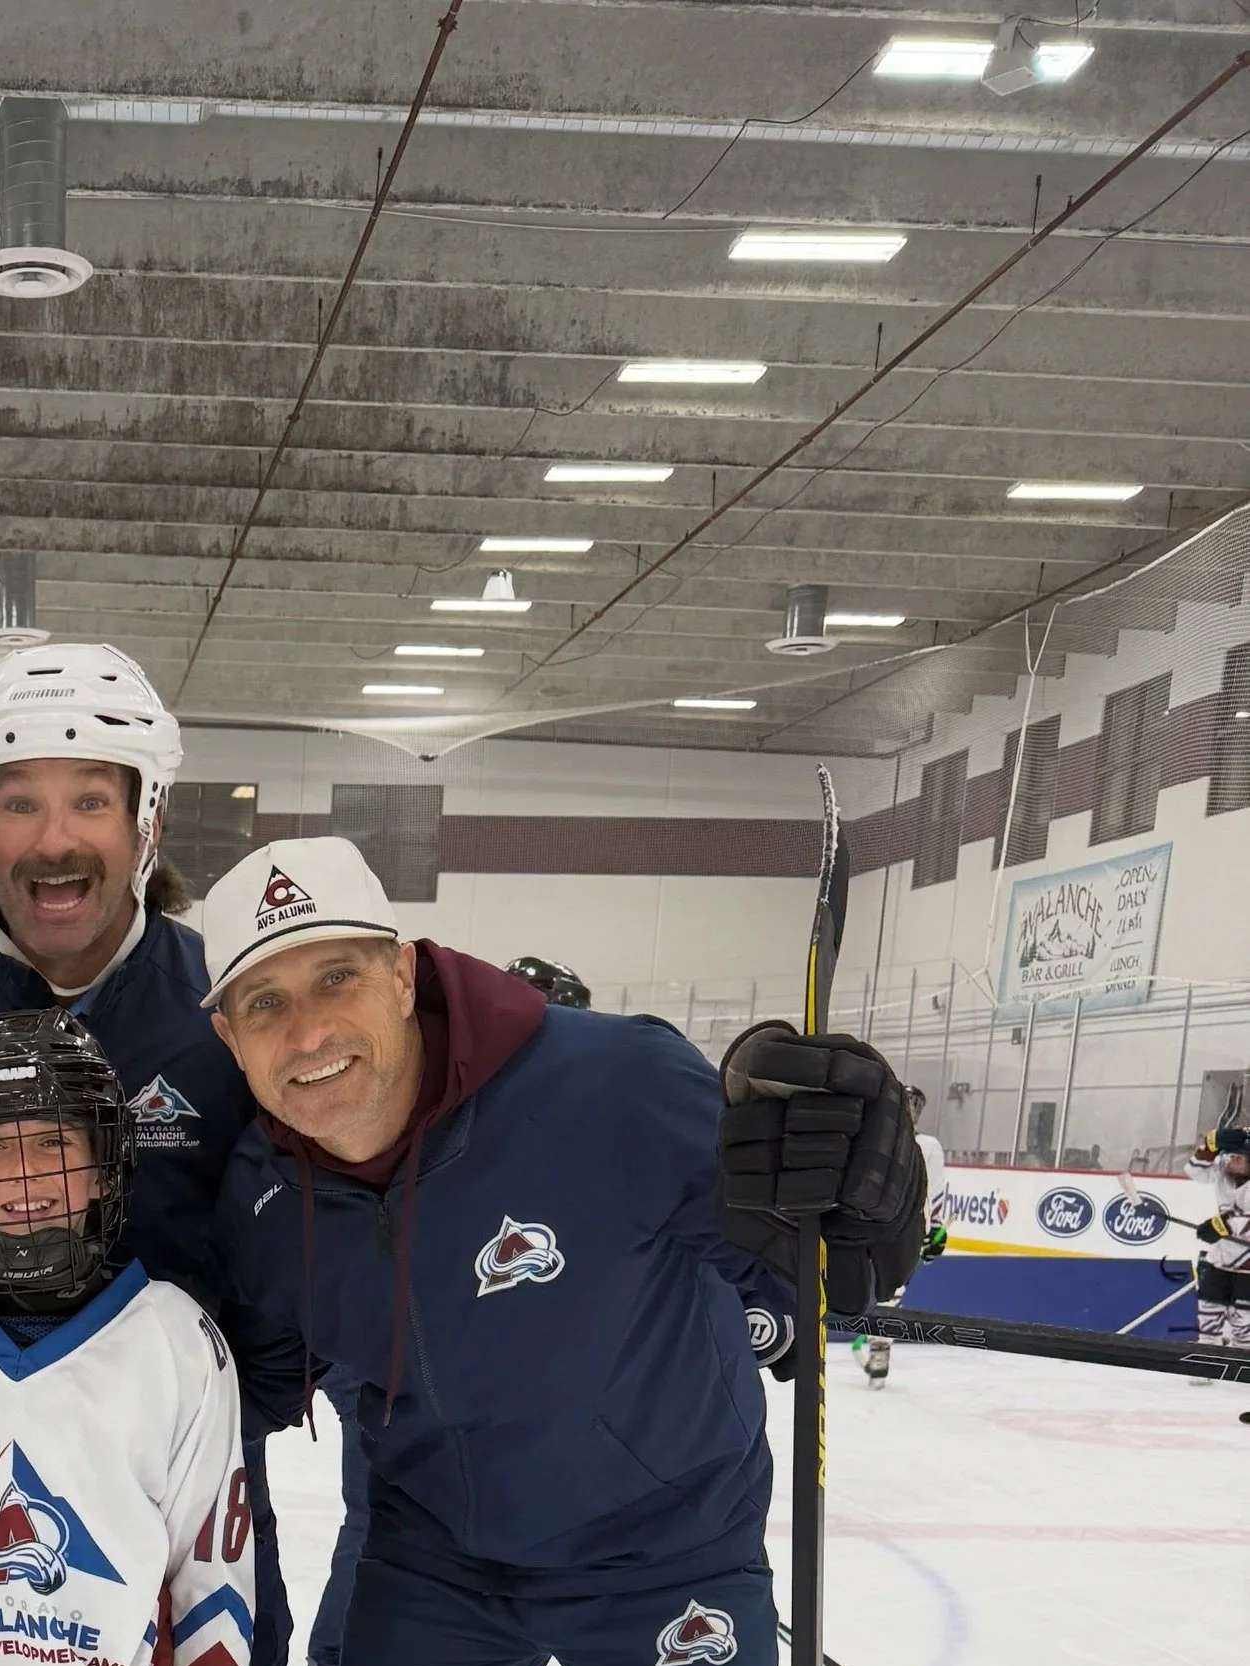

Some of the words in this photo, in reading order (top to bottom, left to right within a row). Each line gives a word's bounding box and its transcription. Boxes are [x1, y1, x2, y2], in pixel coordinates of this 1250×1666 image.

[1120, 864, 1157, 887] OPEN
[257, 914, 275, 932] AVS
[278, 902, 317, 922] ALUMNI
[1016, 882, 1103, 952] AVALANCHE
[1021, 966, 1041, 983] BAR
[1044, 967, 1053, 980] &
[1054, 961, 1084, 979] GRILL
[136, 1132, 187, 1140] VALANCHE
[254, 1184, 283, 1217] BAU
[943, 1181, 996, 1224] hwest
[1045, 1194, 1085, 1234] Ford
[818, 1236, 828, 1490] EASTON
